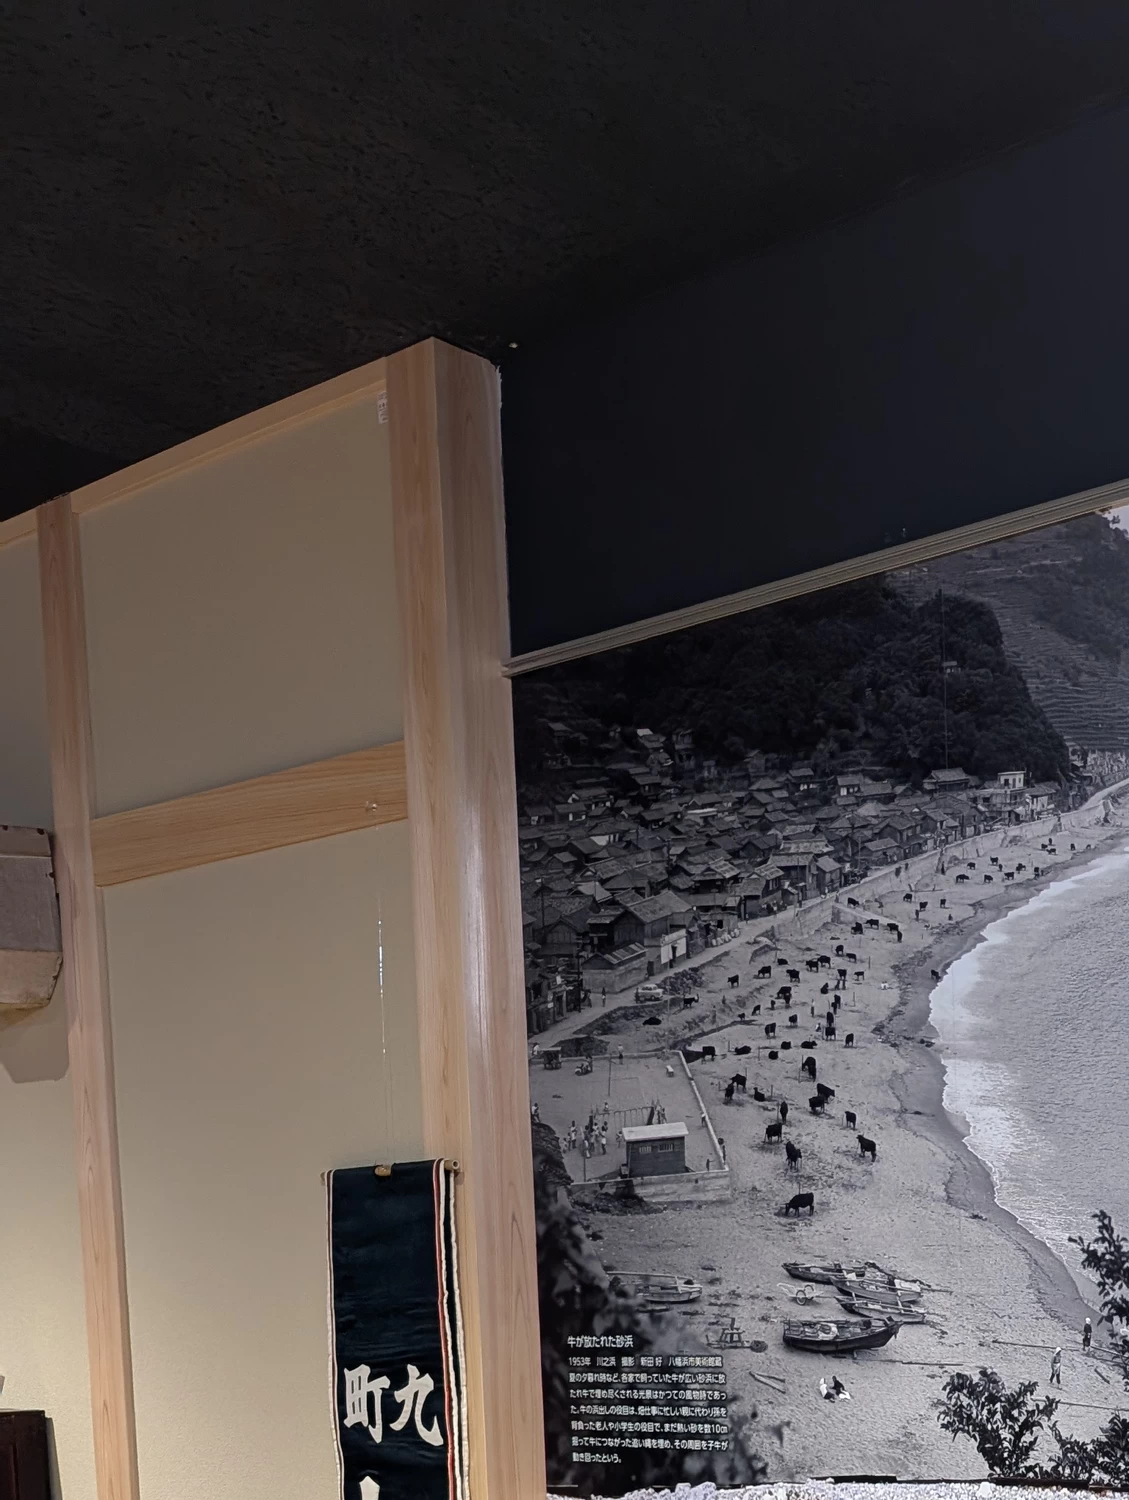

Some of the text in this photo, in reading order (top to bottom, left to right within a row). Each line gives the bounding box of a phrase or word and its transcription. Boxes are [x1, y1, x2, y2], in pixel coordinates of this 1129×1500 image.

[567, 1335, 634, 1348] 牛が放たれた砂浜
[621, 1357, 635, 1367] 撮影
[641, 1357, 654, 1367] 新田
[668, 1357, 723, 1367] 八幡浜市美術館蔵
[572, 1453, 622, 1464] 動き回ったという。
